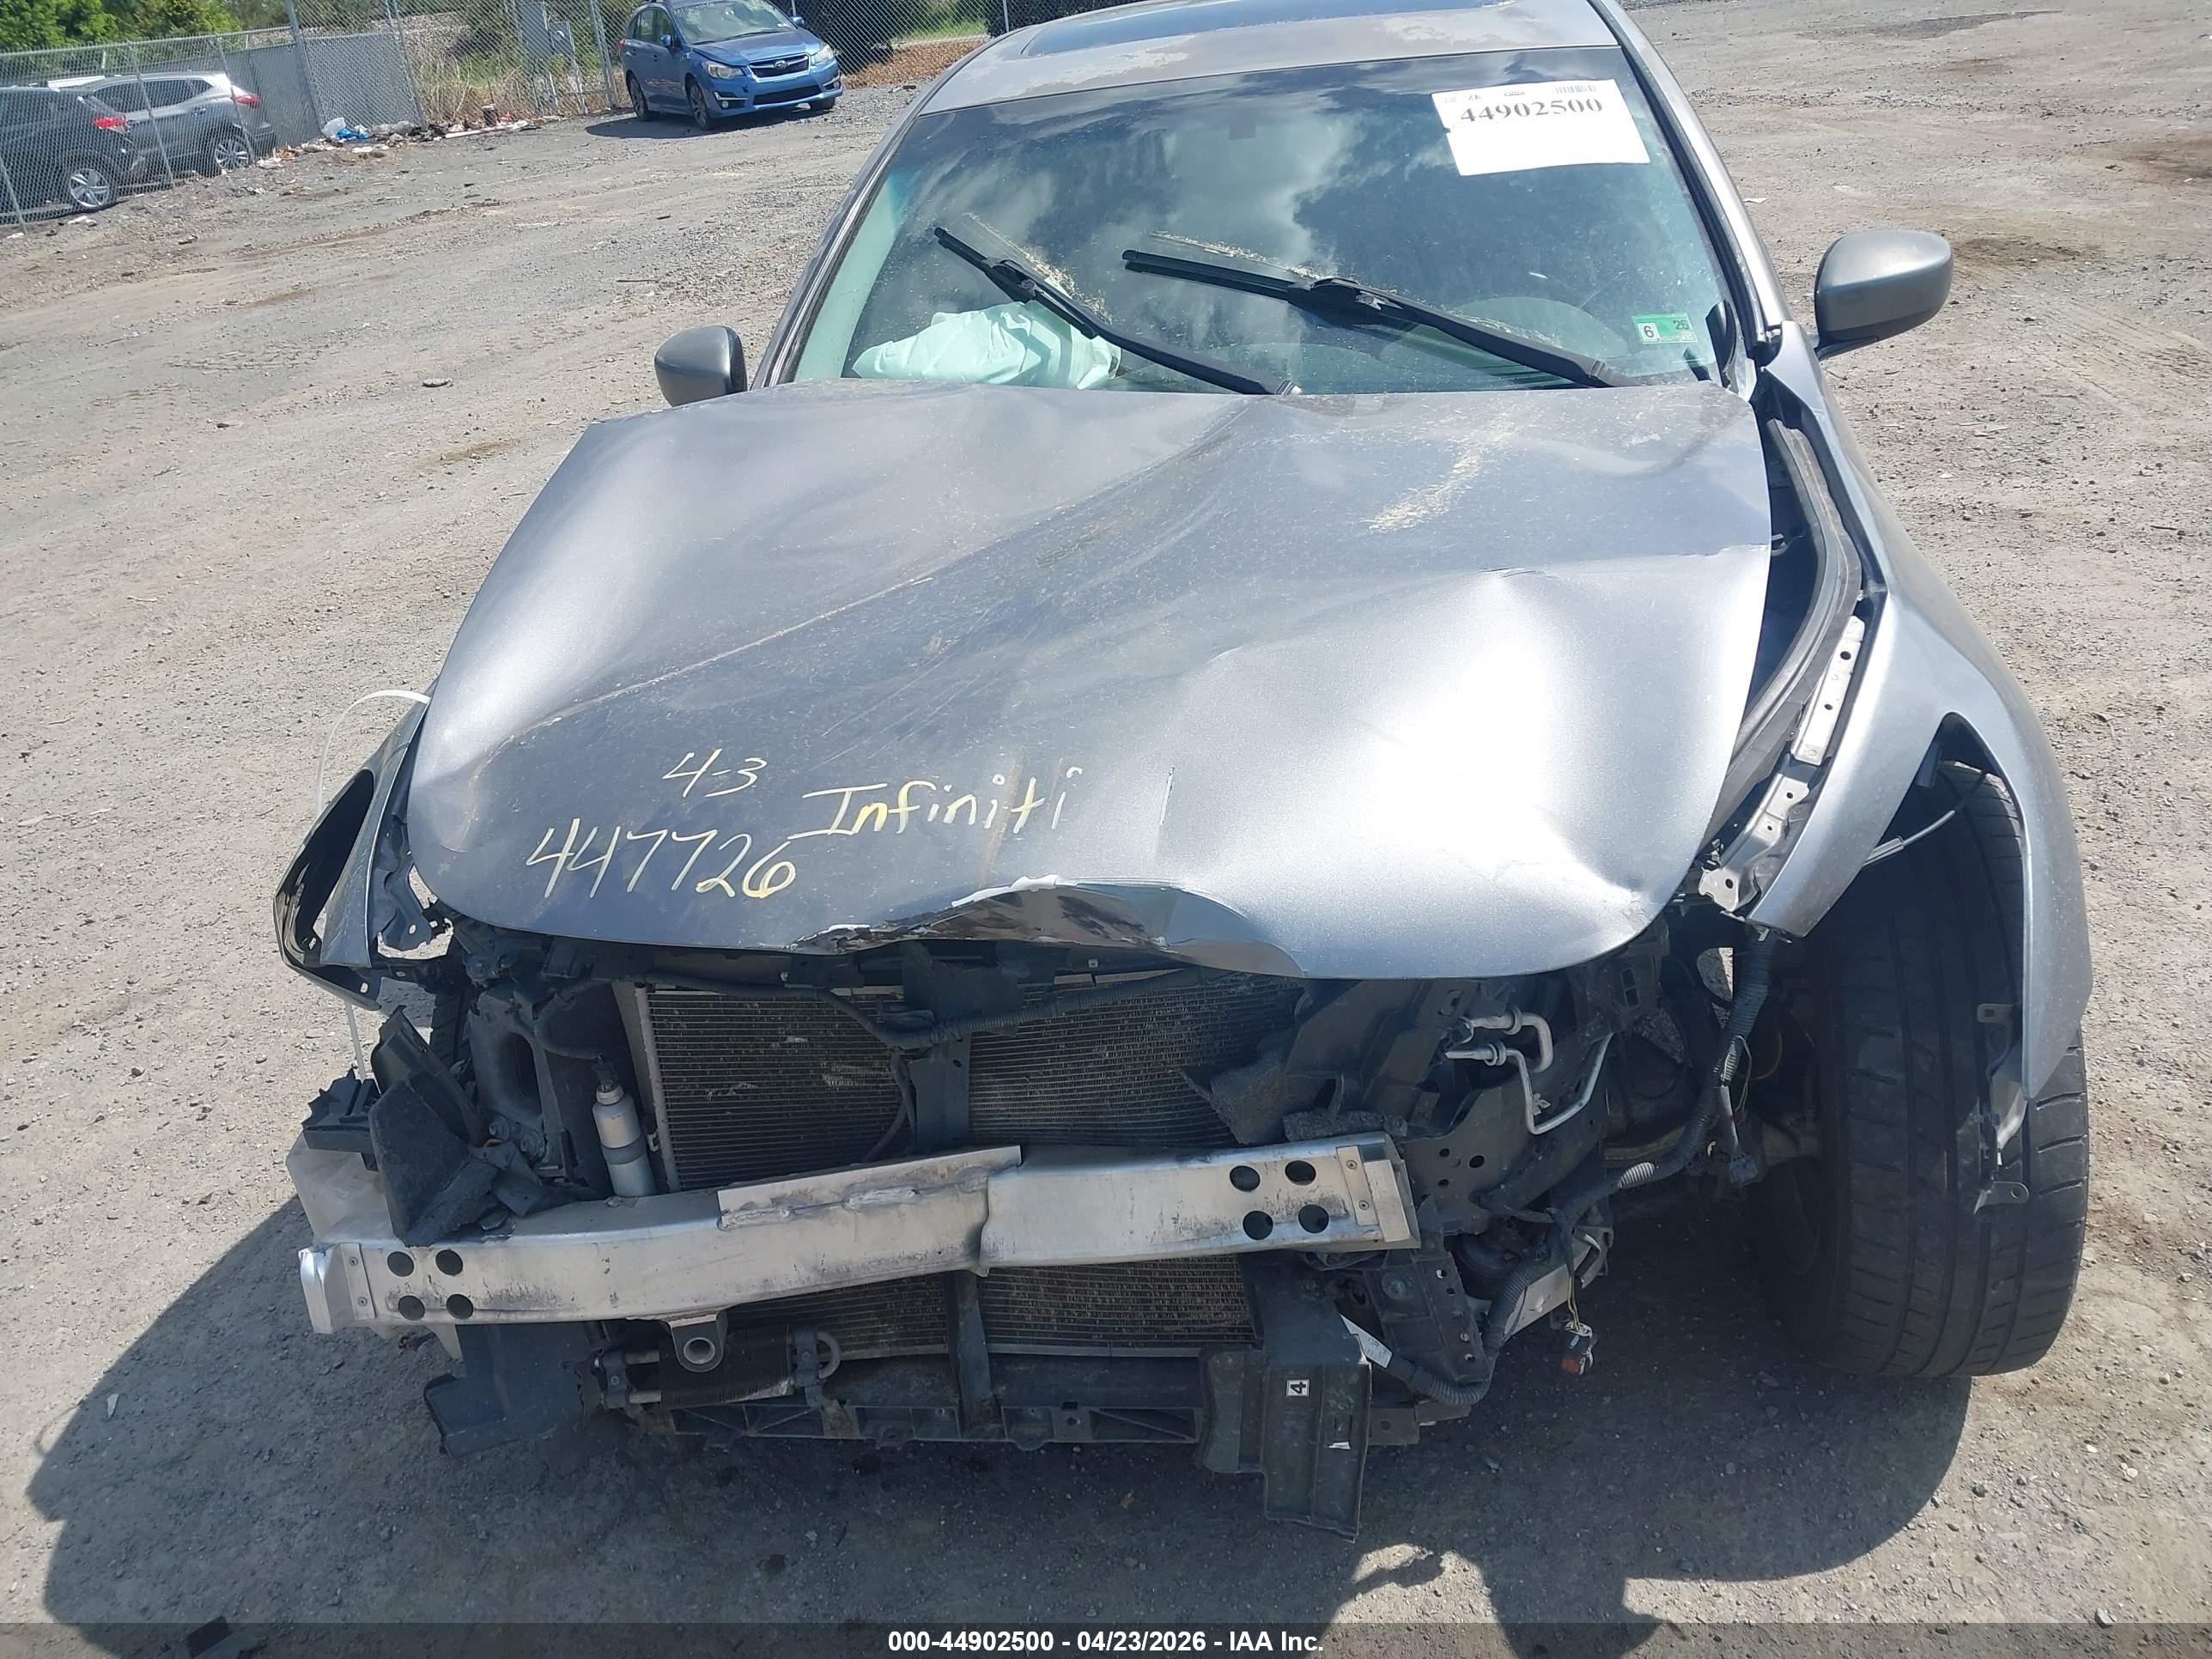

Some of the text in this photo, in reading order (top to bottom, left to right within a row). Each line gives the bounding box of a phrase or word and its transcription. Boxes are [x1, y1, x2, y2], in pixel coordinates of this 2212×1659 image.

[1460, 97, 1603, 123] 44902500
[1643, 325, 1655, 338] 6
[662, 748, 768, 798] 4-3
[787, 767, 1083, 841] Infiniti
[526, 817, 797, 899] 447726
[1290, 1381, 1307, 1395] 4
